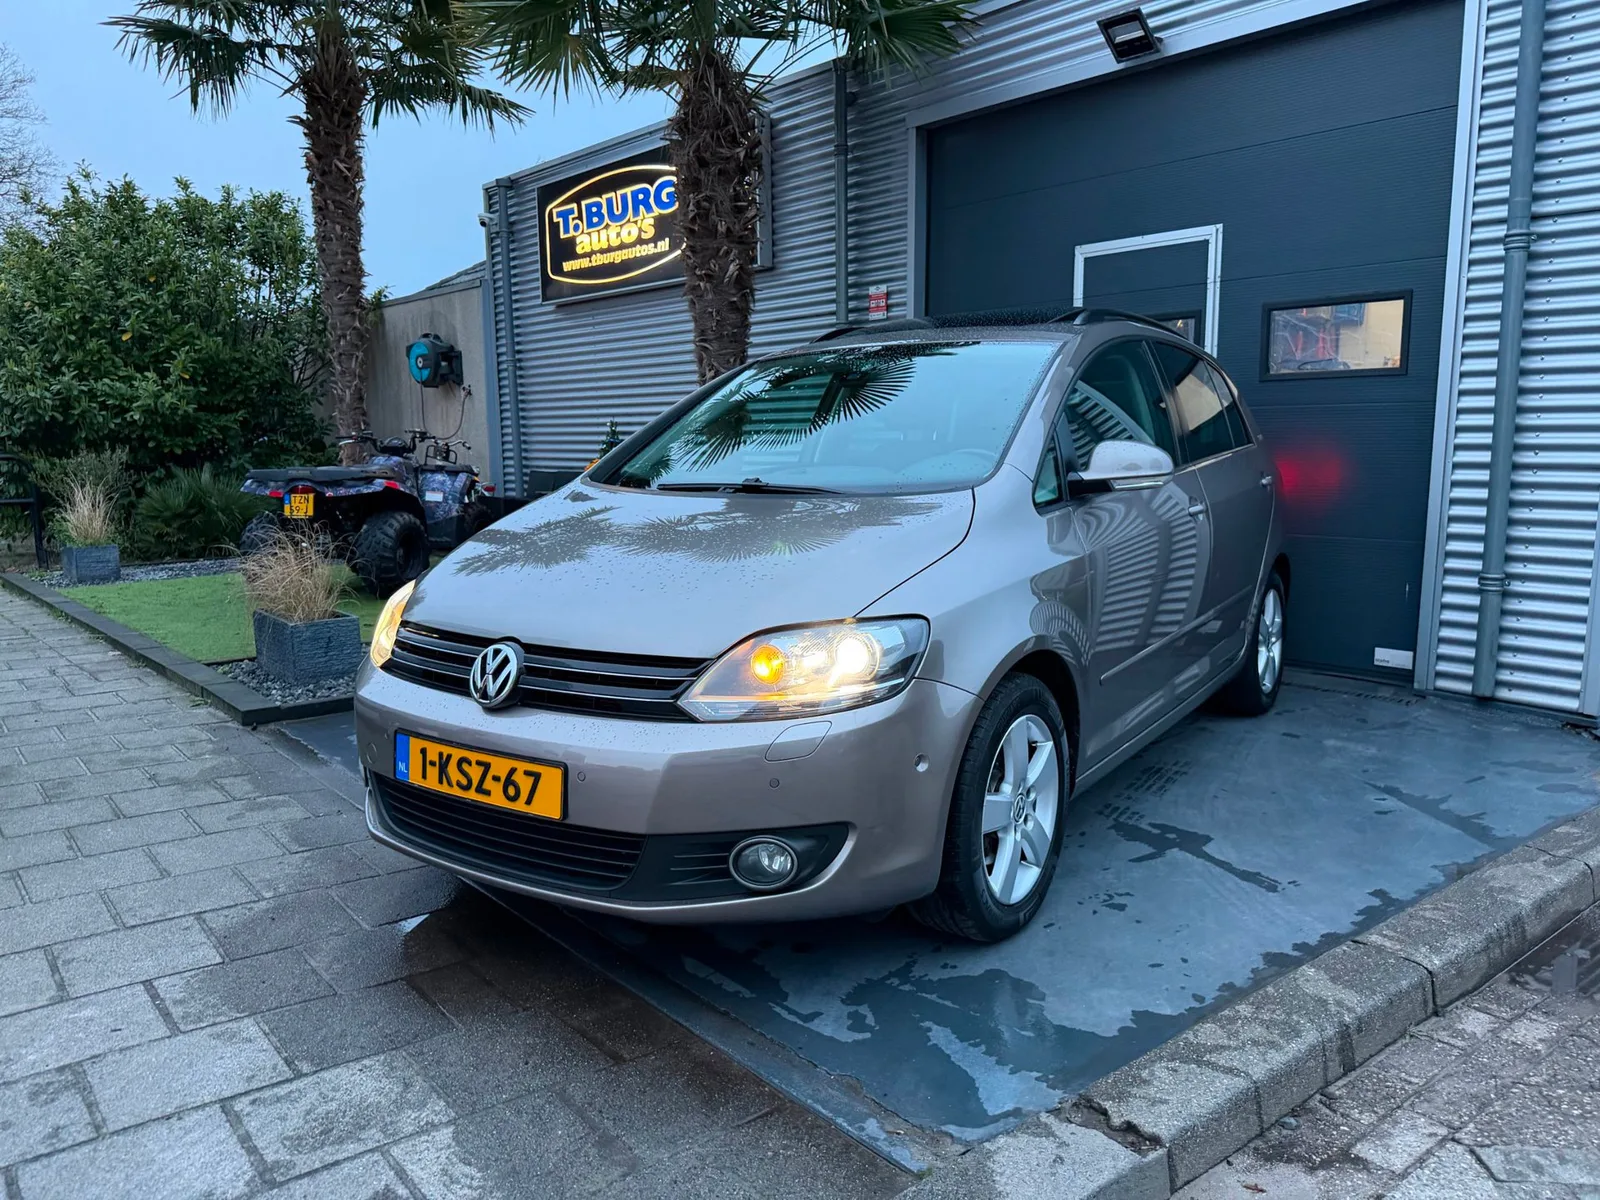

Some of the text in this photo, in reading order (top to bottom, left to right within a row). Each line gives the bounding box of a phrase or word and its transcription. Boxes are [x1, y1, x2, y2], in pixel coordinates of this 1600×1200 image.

[575, 217, 656, 254] auto's
[562, 237, 670, 272] www.tburgautos.nl
[398, 760, 408, 773] NL
[419, 747, 542, 806] 1-KSZ-67
